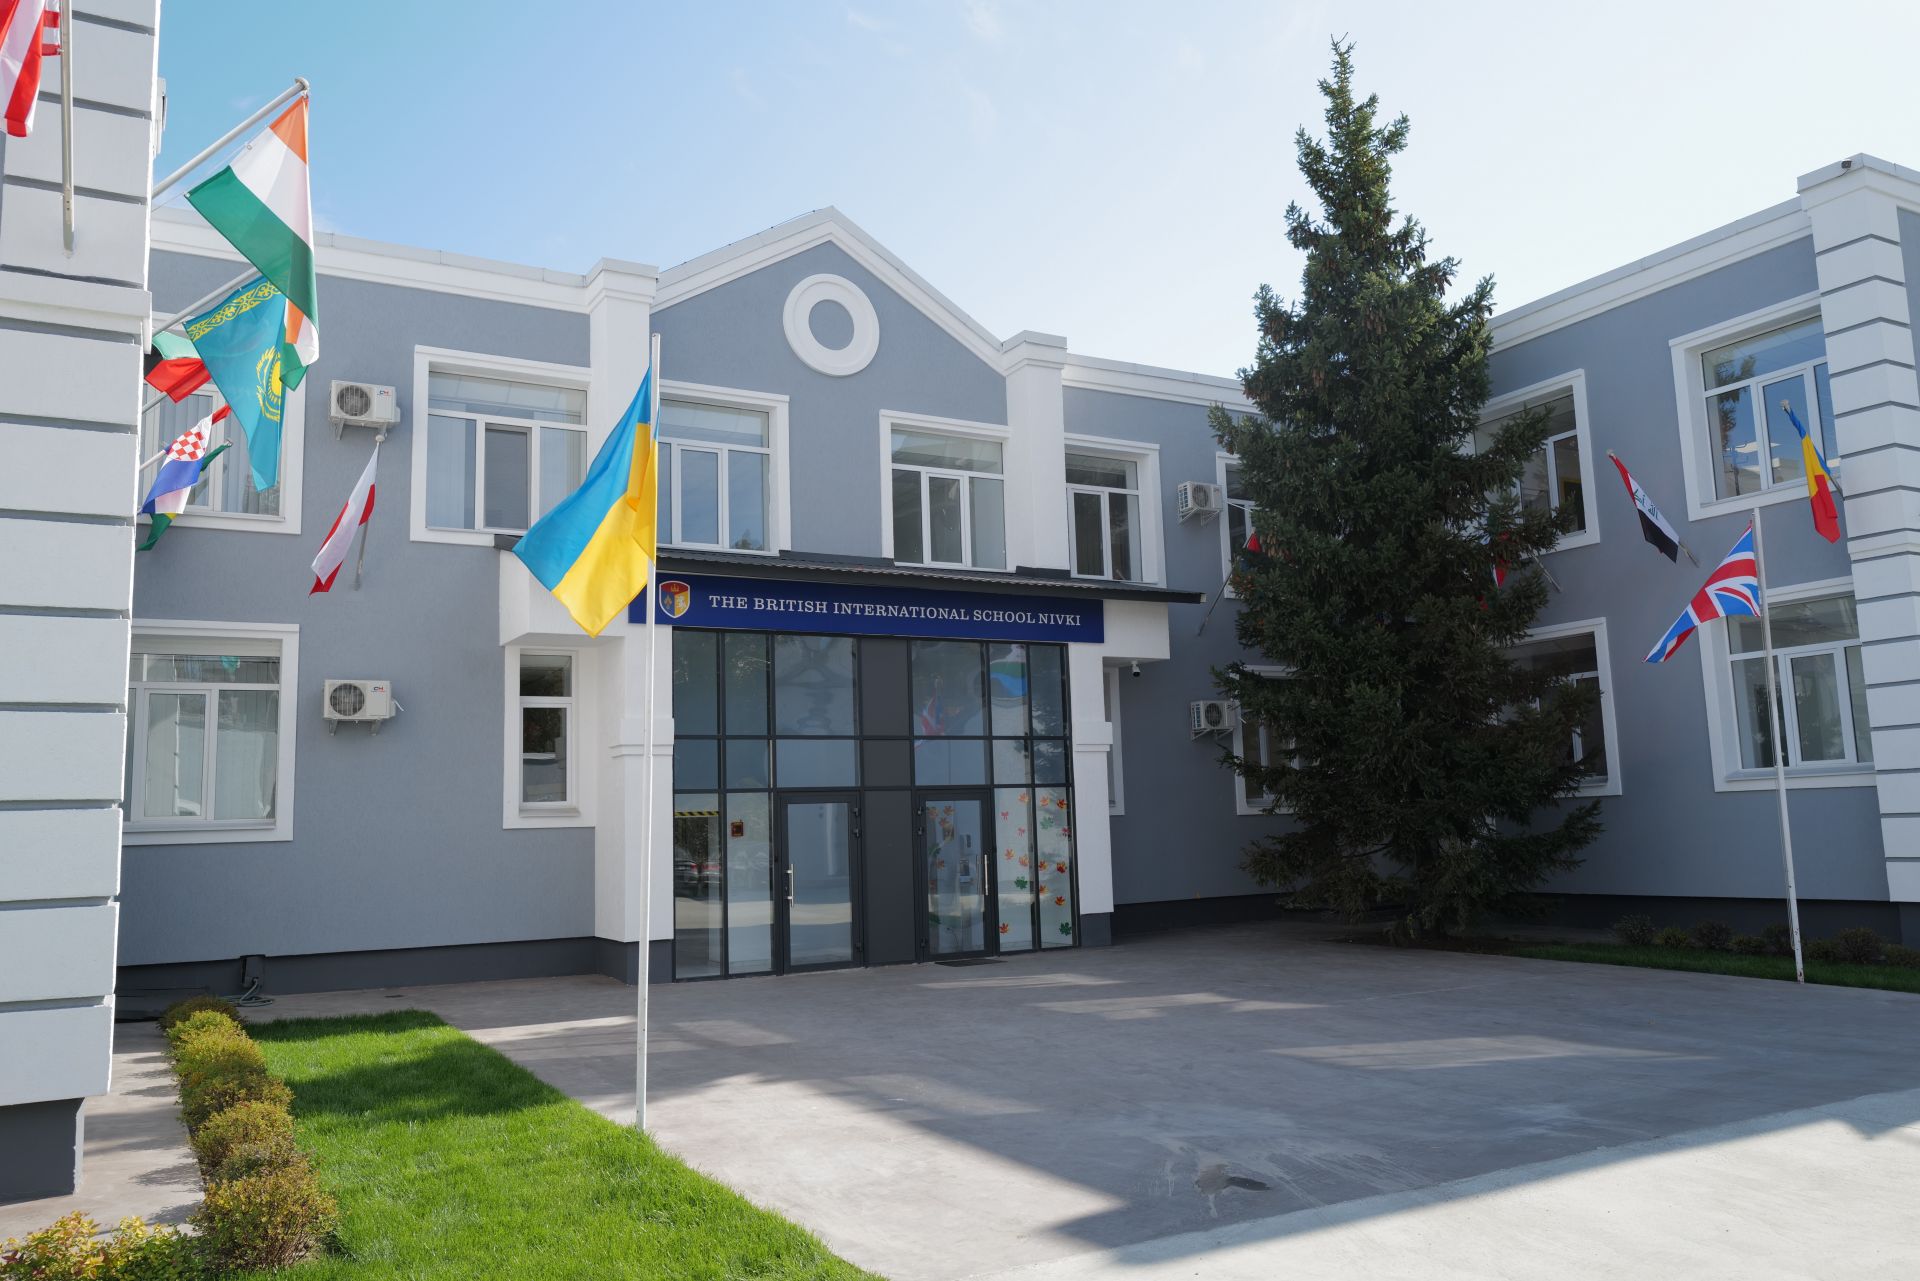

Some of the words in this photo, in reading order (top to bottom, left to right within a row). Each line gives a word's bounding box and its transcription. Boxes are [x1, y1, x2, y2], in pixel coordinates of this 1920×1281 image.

[709, 595, 748, 609] THE
[753, 598, 828, 613] BRITISH
[833, 602, 969, 620] INTERNATIONAL
[973, 610, 1036, 624] SCHOOL
[1038, 613, 1081, 626] NIVKI
